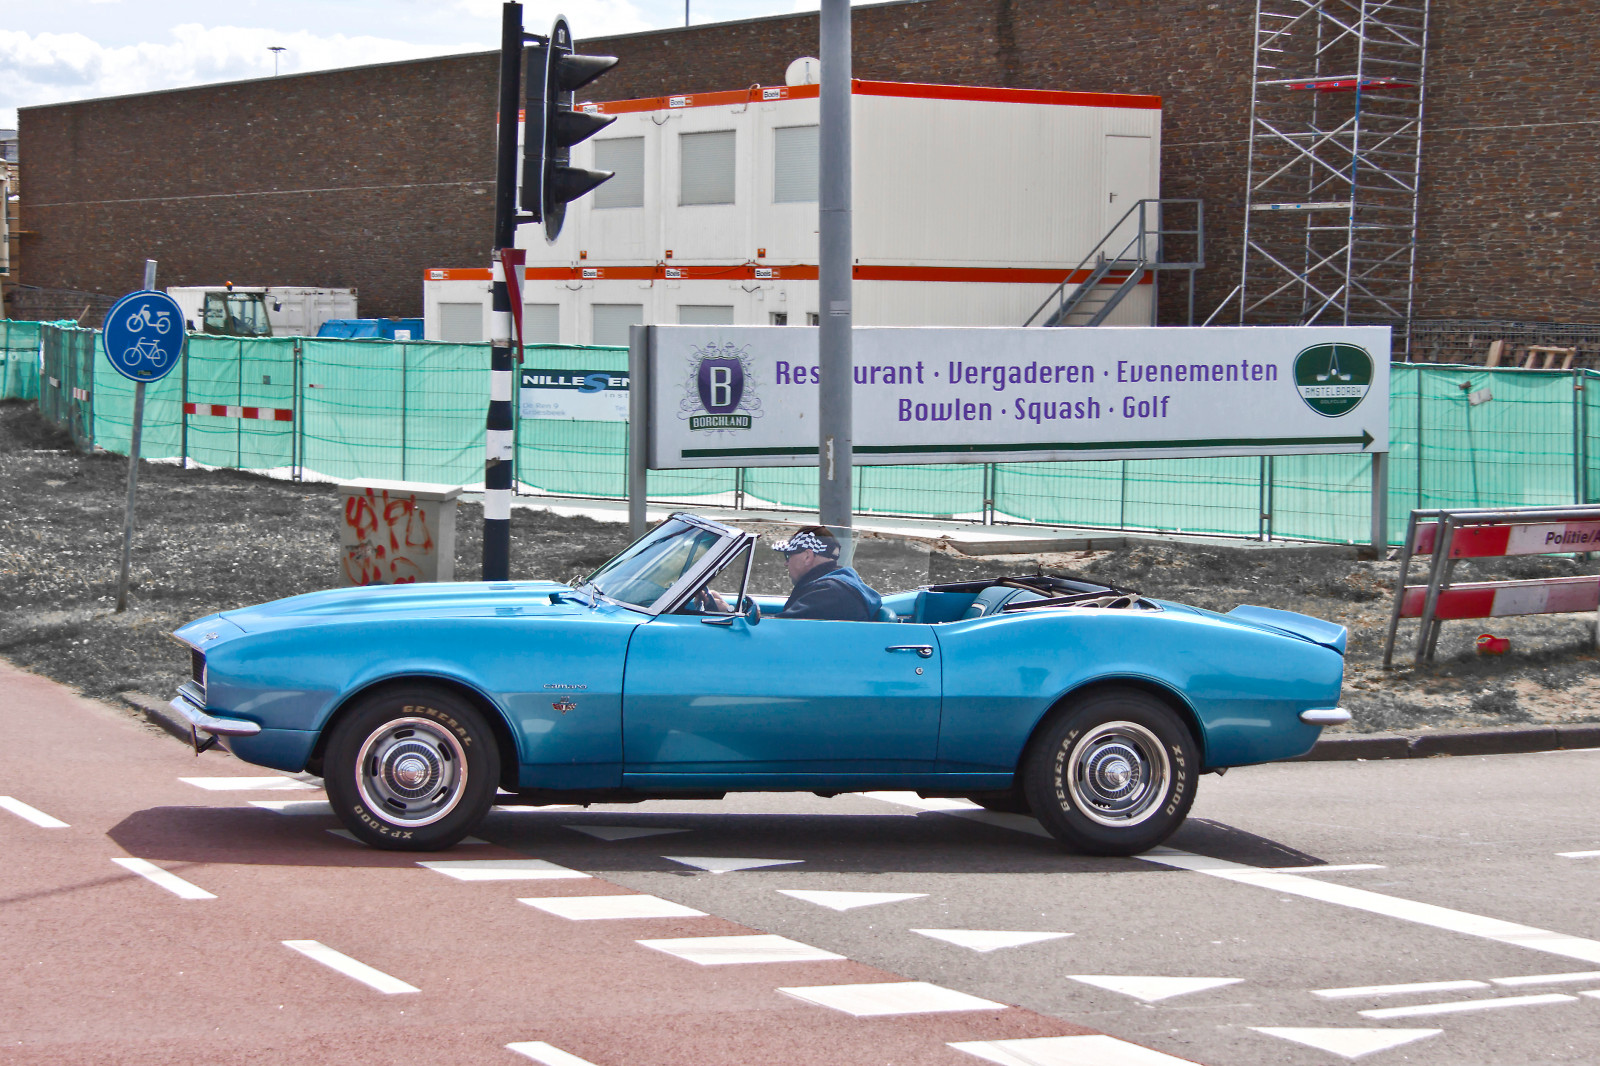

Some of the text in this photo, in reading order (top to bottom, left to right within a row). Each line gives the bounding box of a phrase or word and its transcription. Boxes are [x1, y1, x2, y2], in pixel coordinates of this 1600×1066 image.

[710, 366, 731, 407] B
[776, 359, 1278, 391] Resurant Vergaderen Evenementen
[693, 416, 748, 428] BORCHLAND
[899, 395, 1170, 425] Bowlen Squash Golf
[402, 705, 473, 747] GENERAL
[1054, 729, 1080, 812] GENERAL
